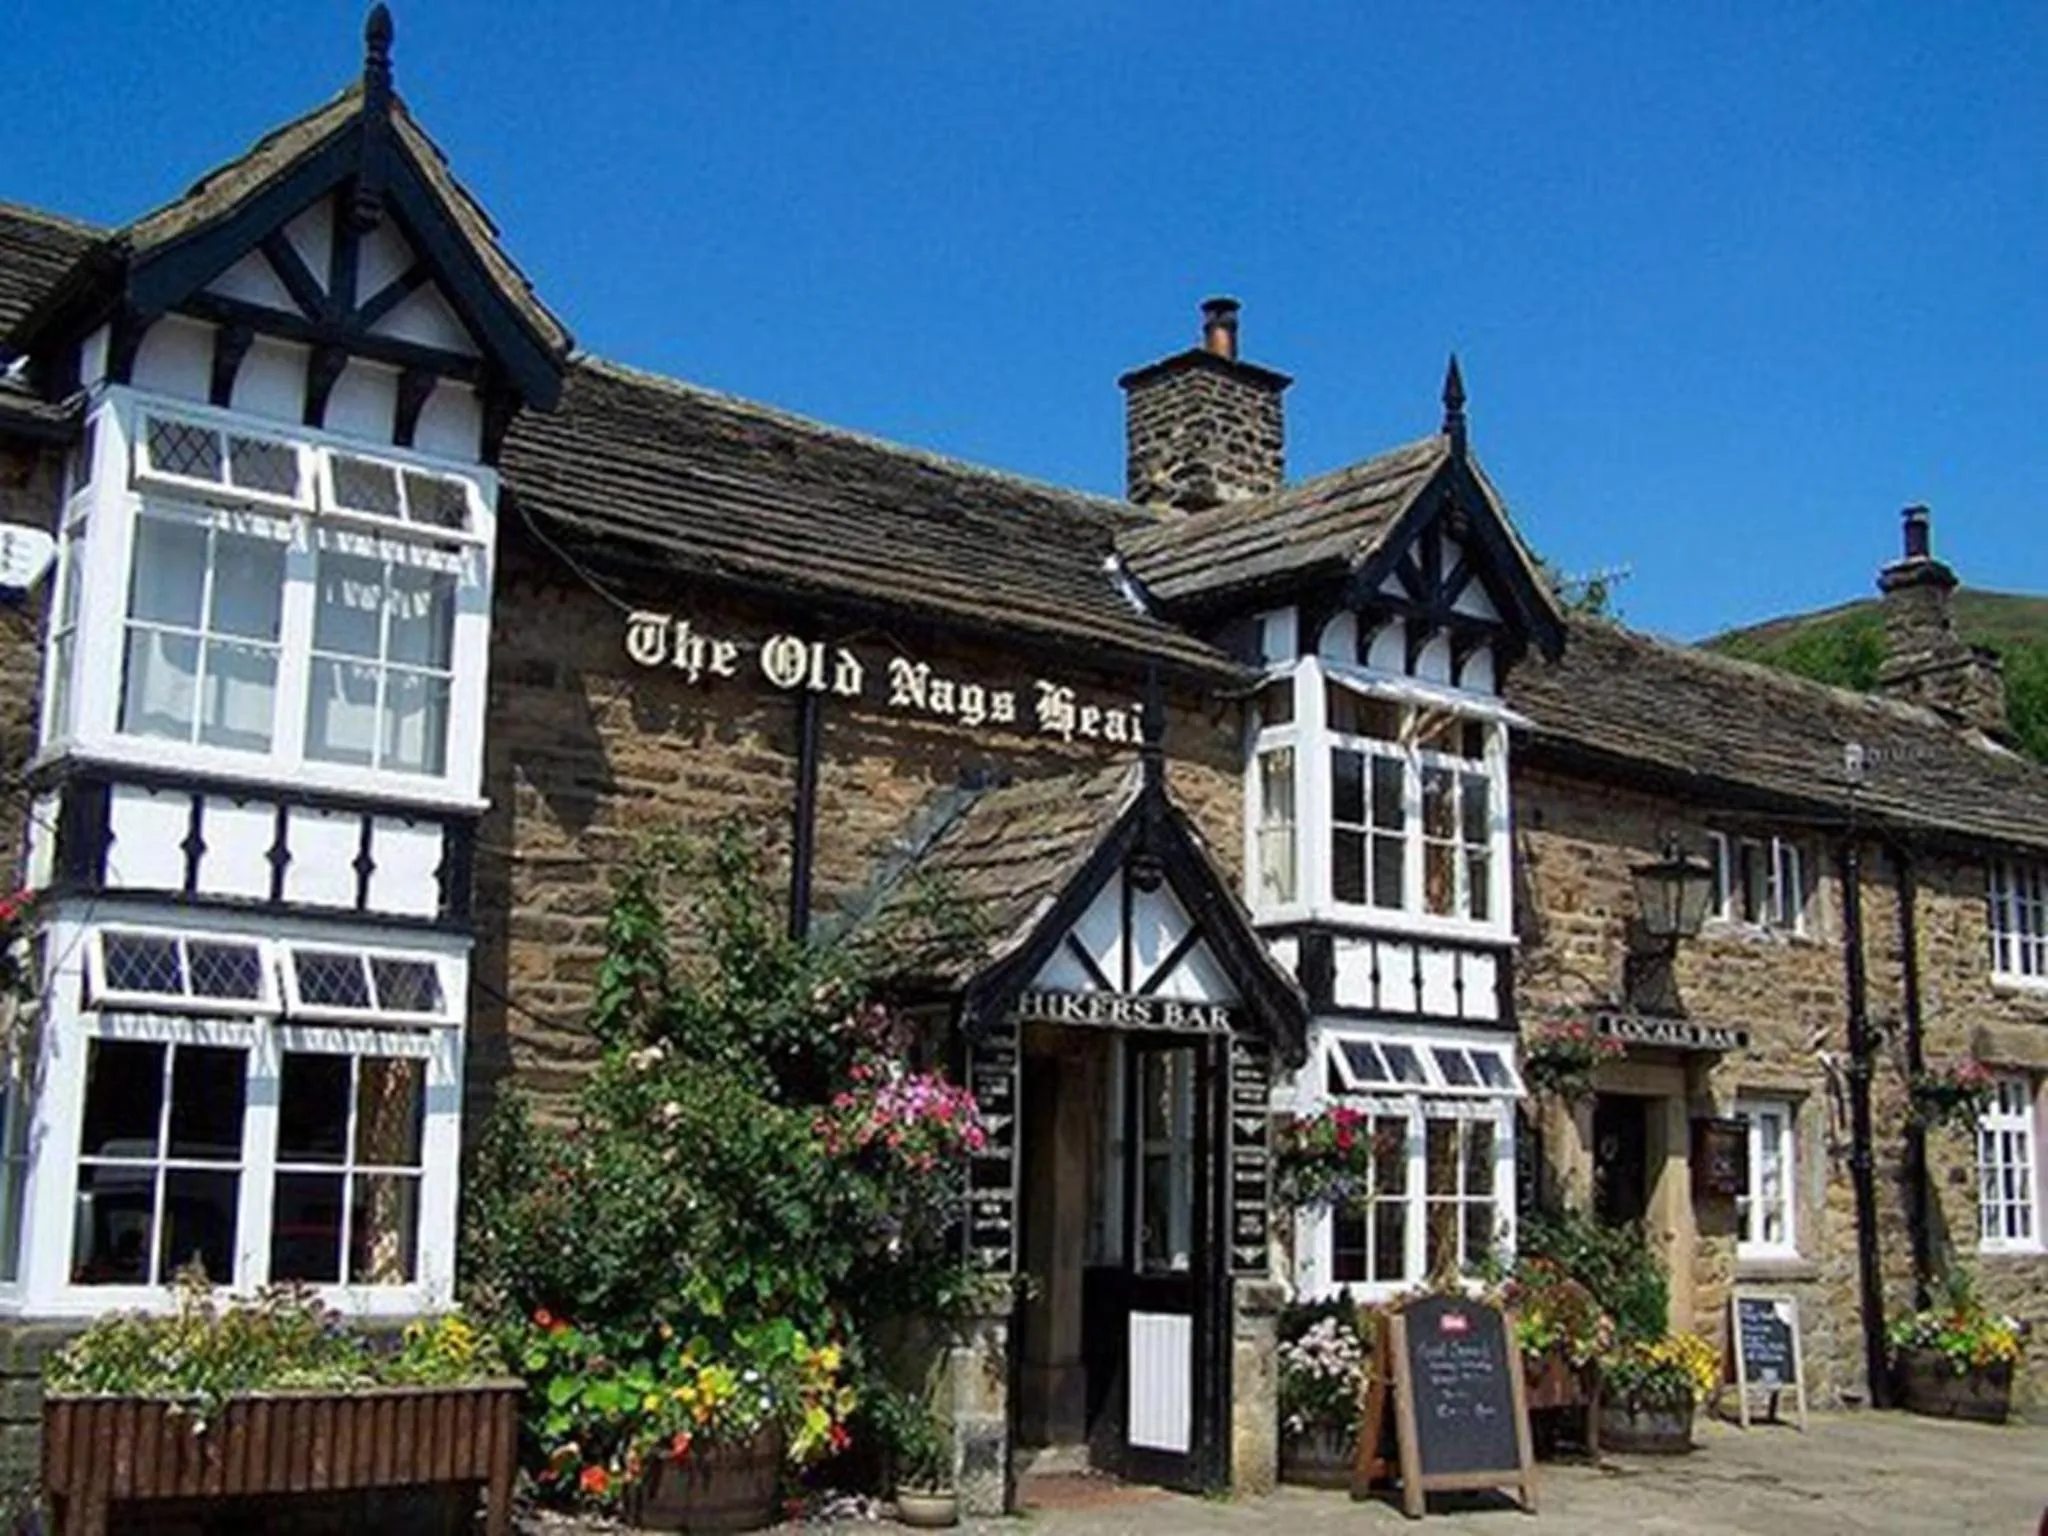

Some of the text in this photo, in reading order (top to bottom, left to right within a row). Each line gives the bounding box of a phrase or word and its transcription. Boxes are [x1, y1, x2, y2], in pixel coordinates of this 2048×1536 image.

[626, 610, 738, 682] The
[760, 634, 864, 696] Old
[888, 656, 1016, 727] Nags
[1018, 992, 1233, 1031] HIKERS BAR
